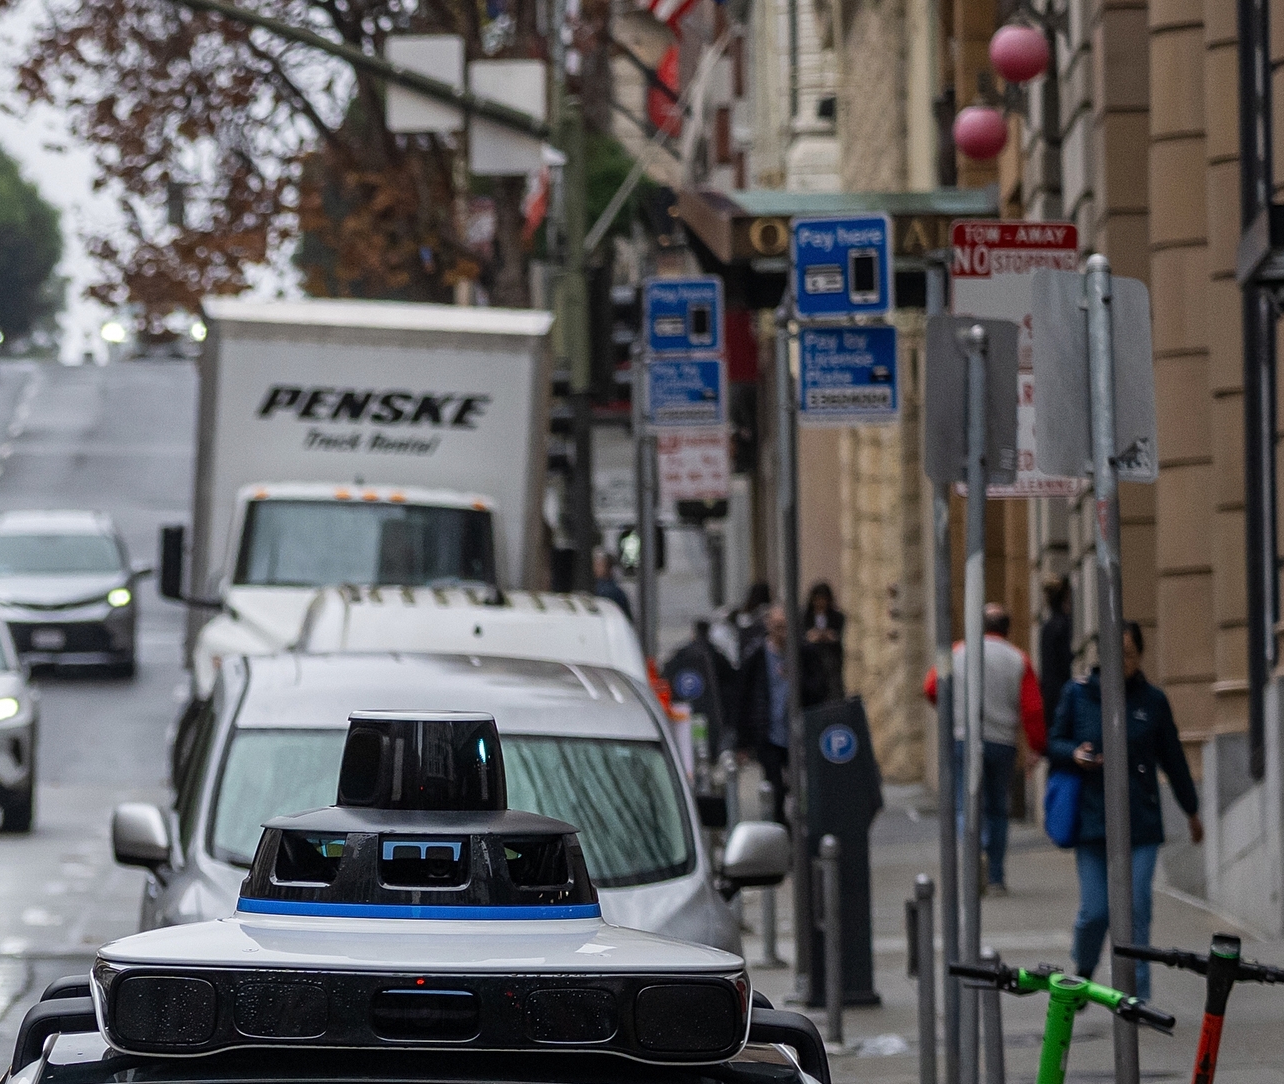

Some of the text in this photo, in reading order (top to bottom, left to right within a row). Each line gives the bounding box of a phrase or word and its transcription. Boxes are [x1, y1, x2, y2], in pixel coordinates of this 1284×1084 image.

[798, 228, 835, 251] Pay
[836, 225, 883, 247] here
[954, 246, 989, 275] NO
[257, 385, 490, 429] PENSKE
